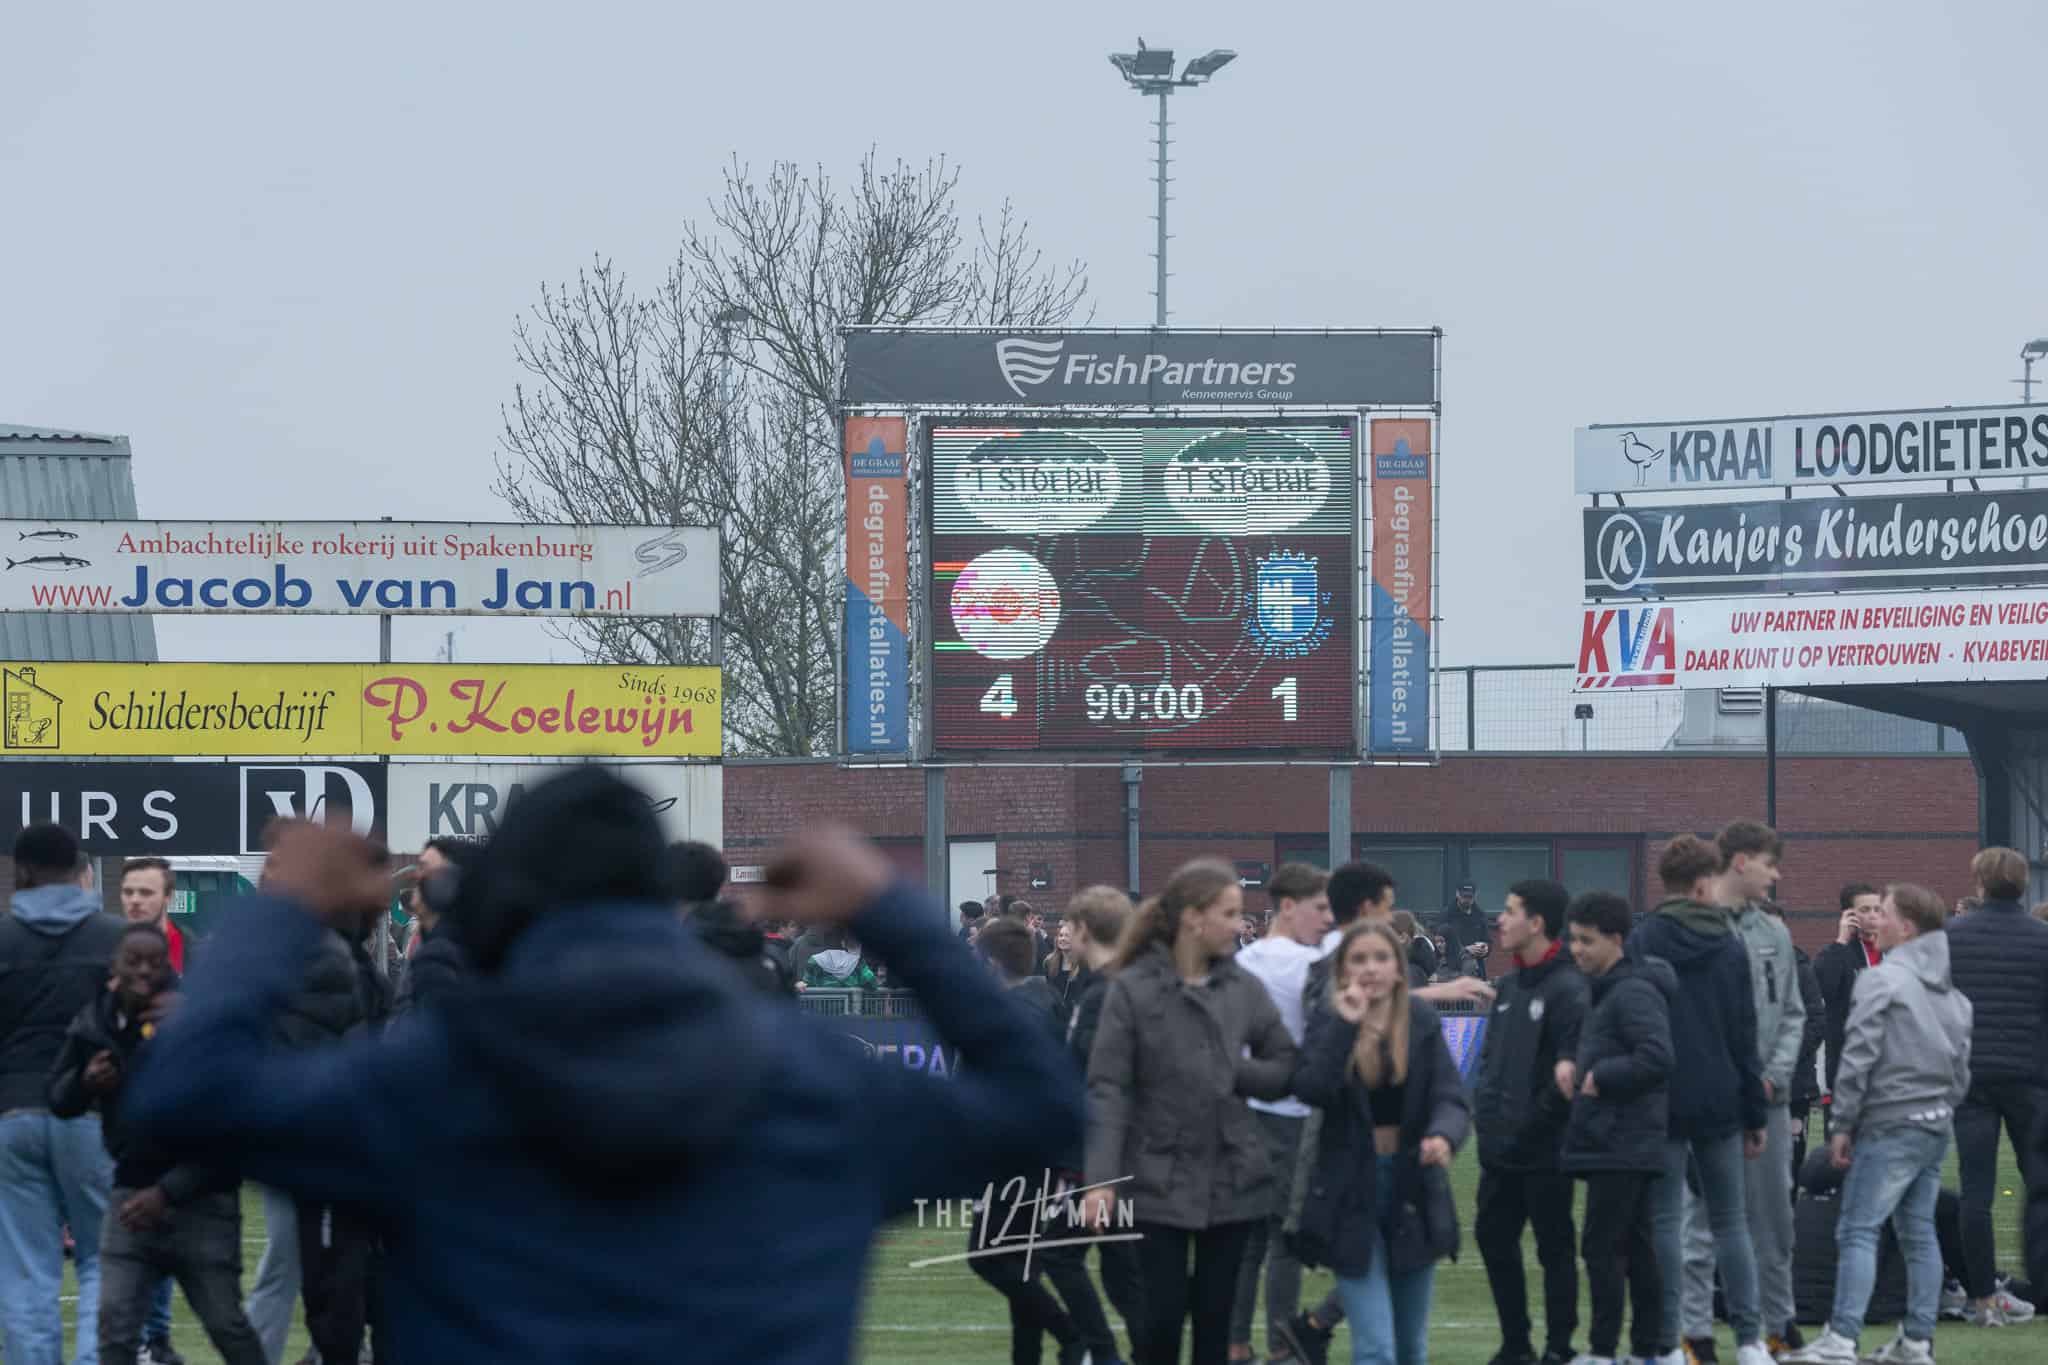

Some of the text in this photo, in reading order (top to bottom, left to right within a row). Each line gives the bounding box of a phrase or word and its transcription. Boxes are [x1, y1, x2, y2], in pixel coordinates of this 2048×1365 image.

[1063, 353, 1297, 386] FishPartners
[1181, 388, 1294, 402] Kennemervis Group
[1669, 414, 2048, 483] KRAAI LOODGIETERS
[115, 531, 593, 562] Ambachtelijke rokerij uit Spakenburg
[1656, 512, 1803, 572] Kanjers
[336, 577, 457, 609] van
[864, 484, 891, 745] degraafinstallaties.nl
[1390, 485, 1416, 745] degraafinstallaties.nl
[1731, 611, 1761, 634] UW
[1763, 609, 1837, 633] PARTNER
[1839, 607, 1860, 631] IN
[1862, 604, 1966, 630] BEVEILIGING
[1969, 603, 1993, 627] EN
[1577, 607, 1676, 674] KVA
[1684, 648, 1730, 672] DAAR
[1732, 647, 1780, 671] KUNT
[1782, 646, 1796, 669] U
[1799, 645, 1824, 668] OP
[1827, 642, 1941, 667] VERTROUWEN
[618, 671, 717, 706] Sinds 1968
[979, 672, 1297, 721] 4 90:00 1
[88, 689, 336, 744] Schildersbedrijf
